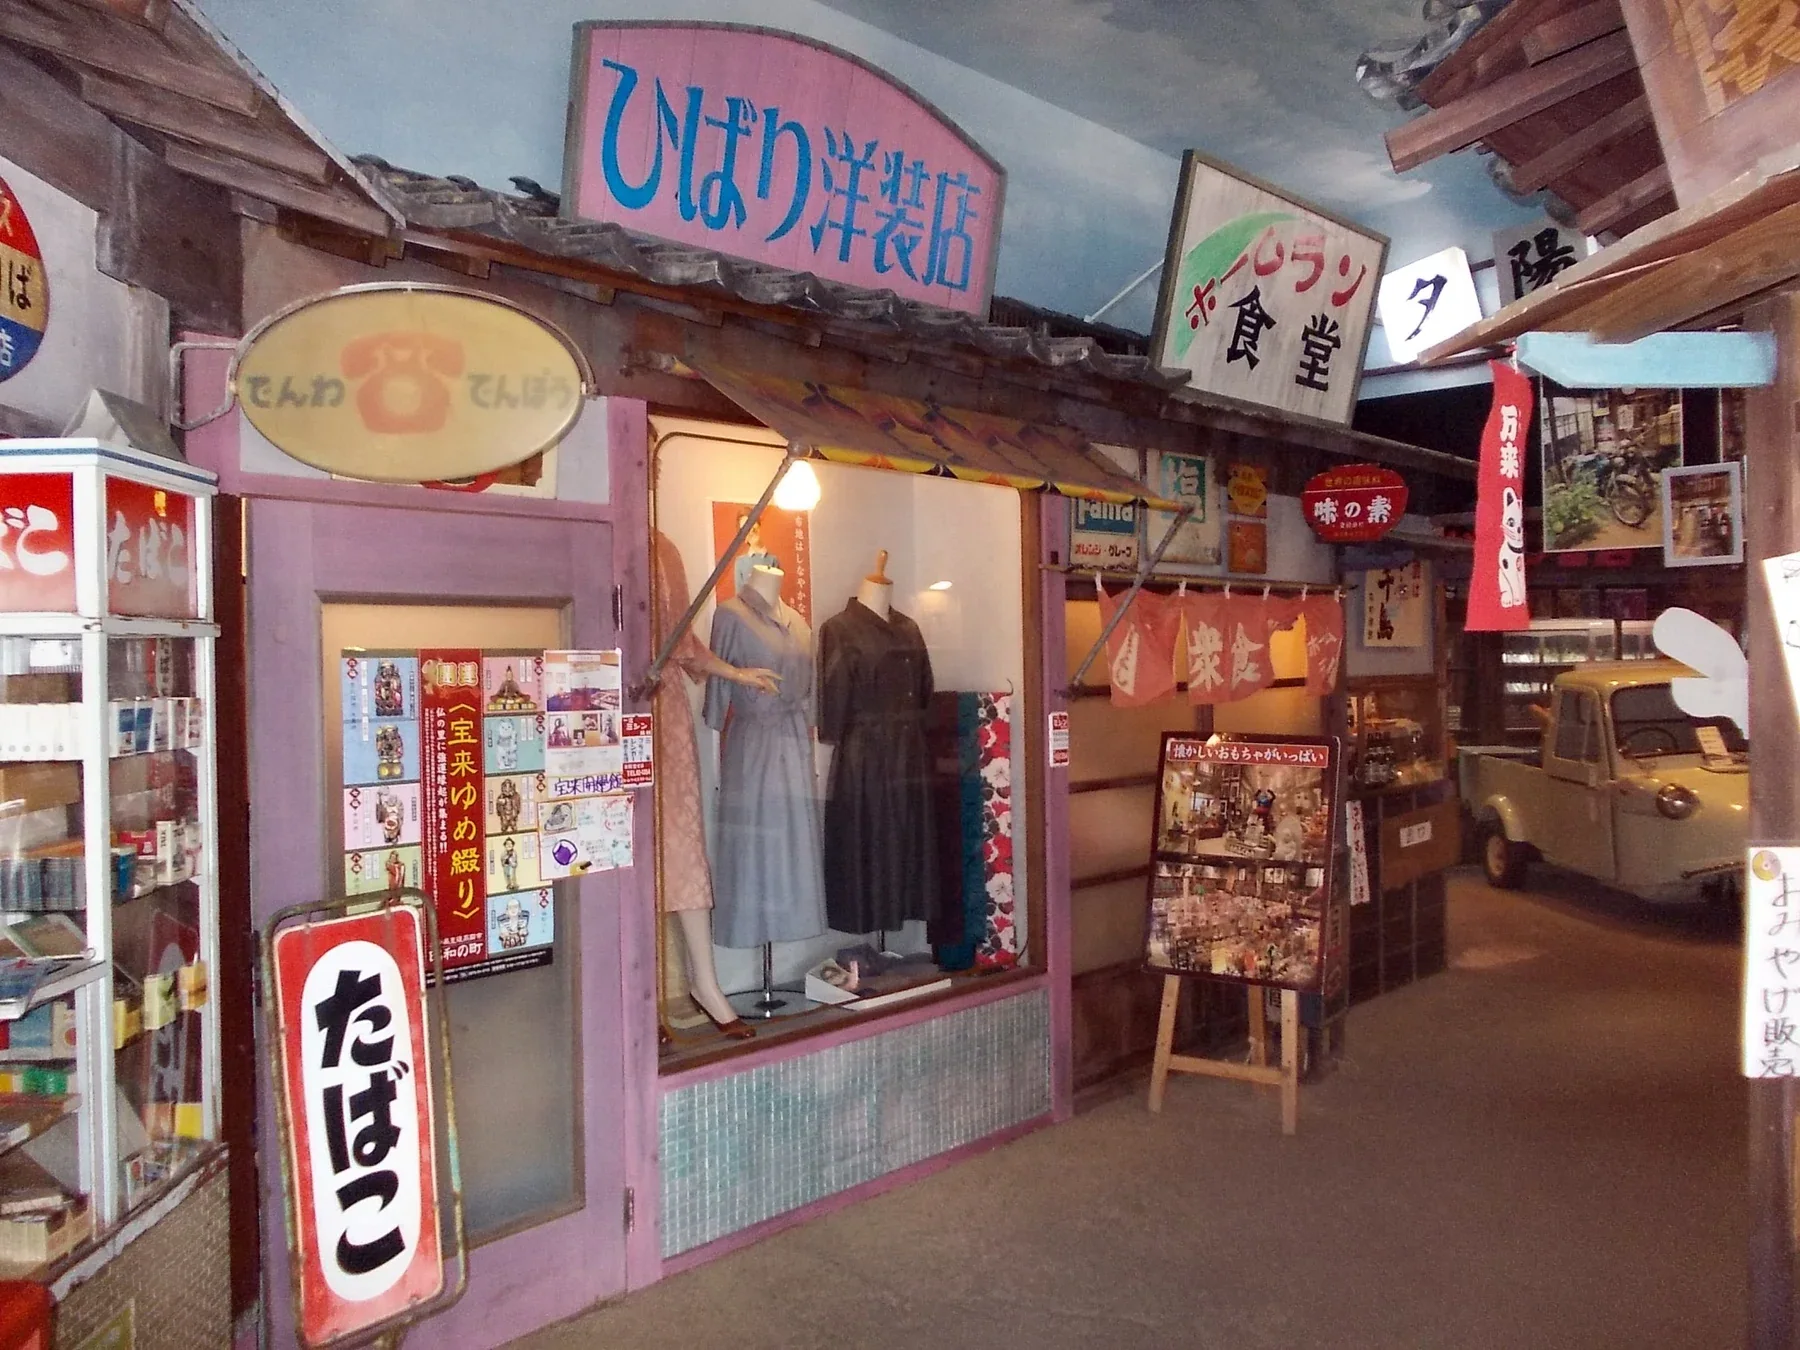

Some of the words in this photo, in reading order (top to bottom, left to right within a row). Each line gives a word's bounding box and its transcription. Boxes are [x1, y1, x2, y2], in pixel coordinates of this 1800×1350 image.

[601, 58, 981, 292] ひばり洋装店
[1227, 285, 1342, 391] 食堂
[246, 372, 346, 409] でんわ
[107, 510, 188, 585] たばこ
[1314, 495, 1392, 525] 味の素
[1173, 743, 1324, 763] 懐かしいおもちゃがいっぱい
[315, 969, 409, 1275] たばこ
